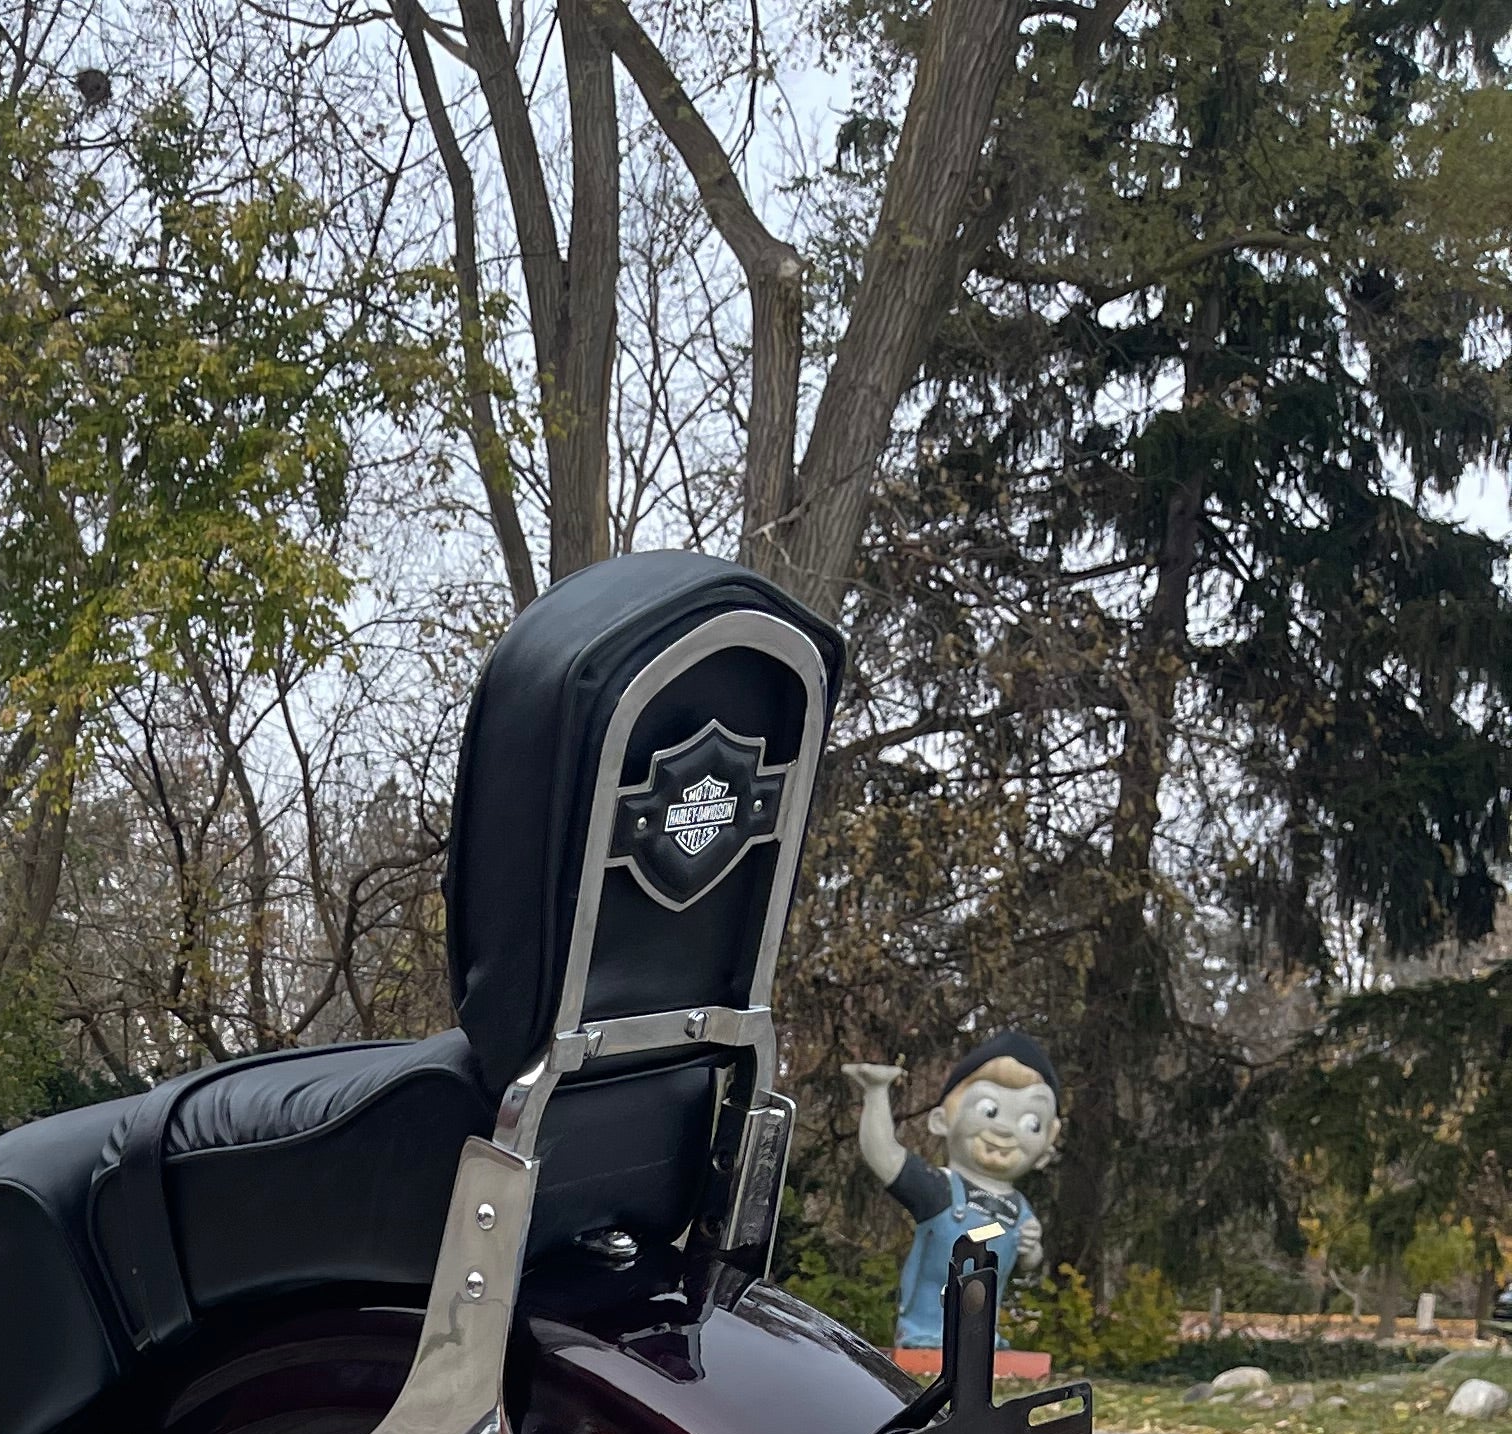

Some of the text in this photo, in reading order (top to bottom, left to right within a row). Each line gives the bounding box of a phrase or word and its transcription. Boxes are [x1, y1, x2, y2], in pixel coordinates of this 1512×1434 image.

[688, 781, 722, 802] MOTOR
[669, 803, 733, 826] HARLEY-DAVIDSON
[680, 826, 714, 850] CYCLES
